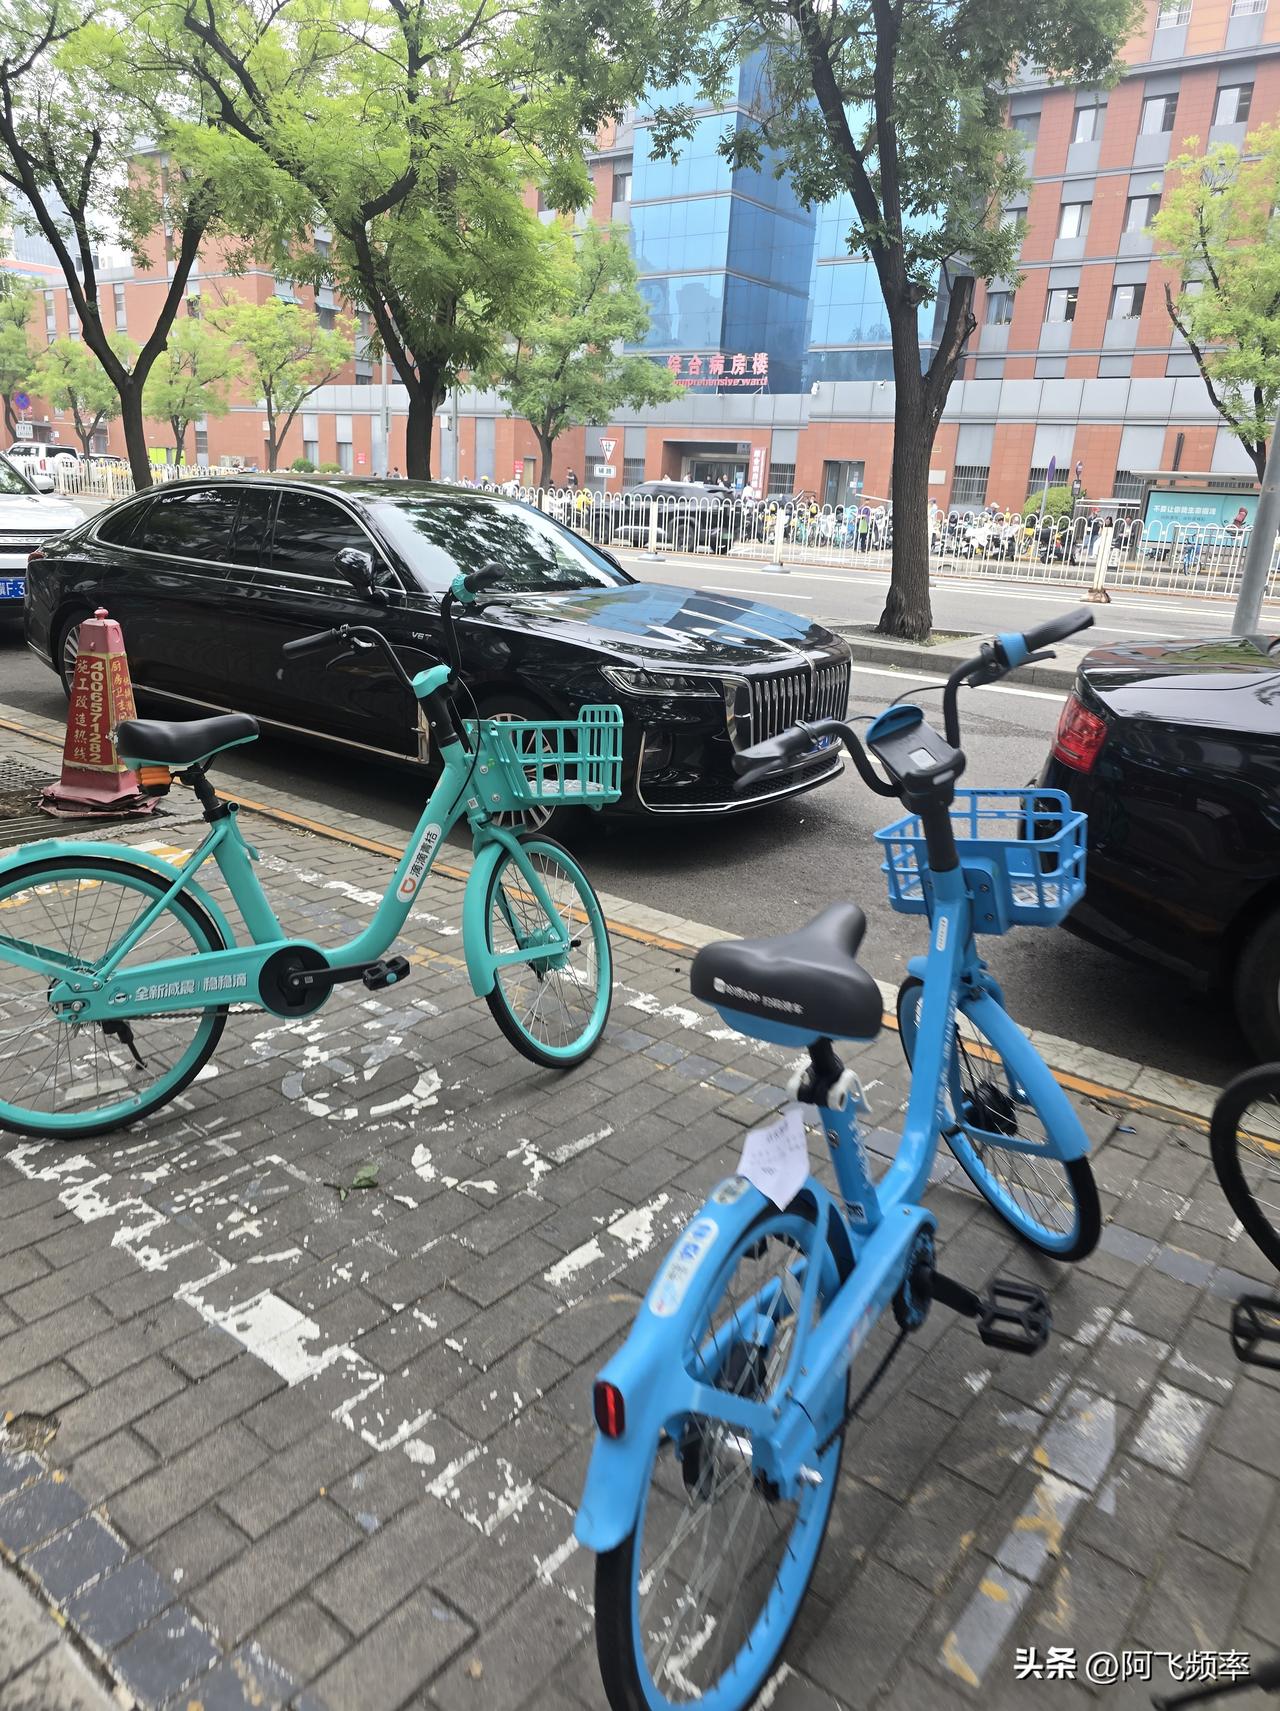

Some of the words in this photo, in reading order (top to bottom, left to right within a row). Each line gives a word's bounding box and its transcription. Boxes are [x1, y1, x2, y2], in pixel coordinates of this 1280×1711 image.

[667, 352, 769, 375] 综合病房楼
[673, 377, 740, 388] omprehensive
[741, 375, 768, 386] ward
[604, 441, 612, 452] 让
[73, 660, 90, 762] 施工改造热线
[89, 661, 105, 763] 4006571282
[410, 831, 438, 878] 滴滴青桔
